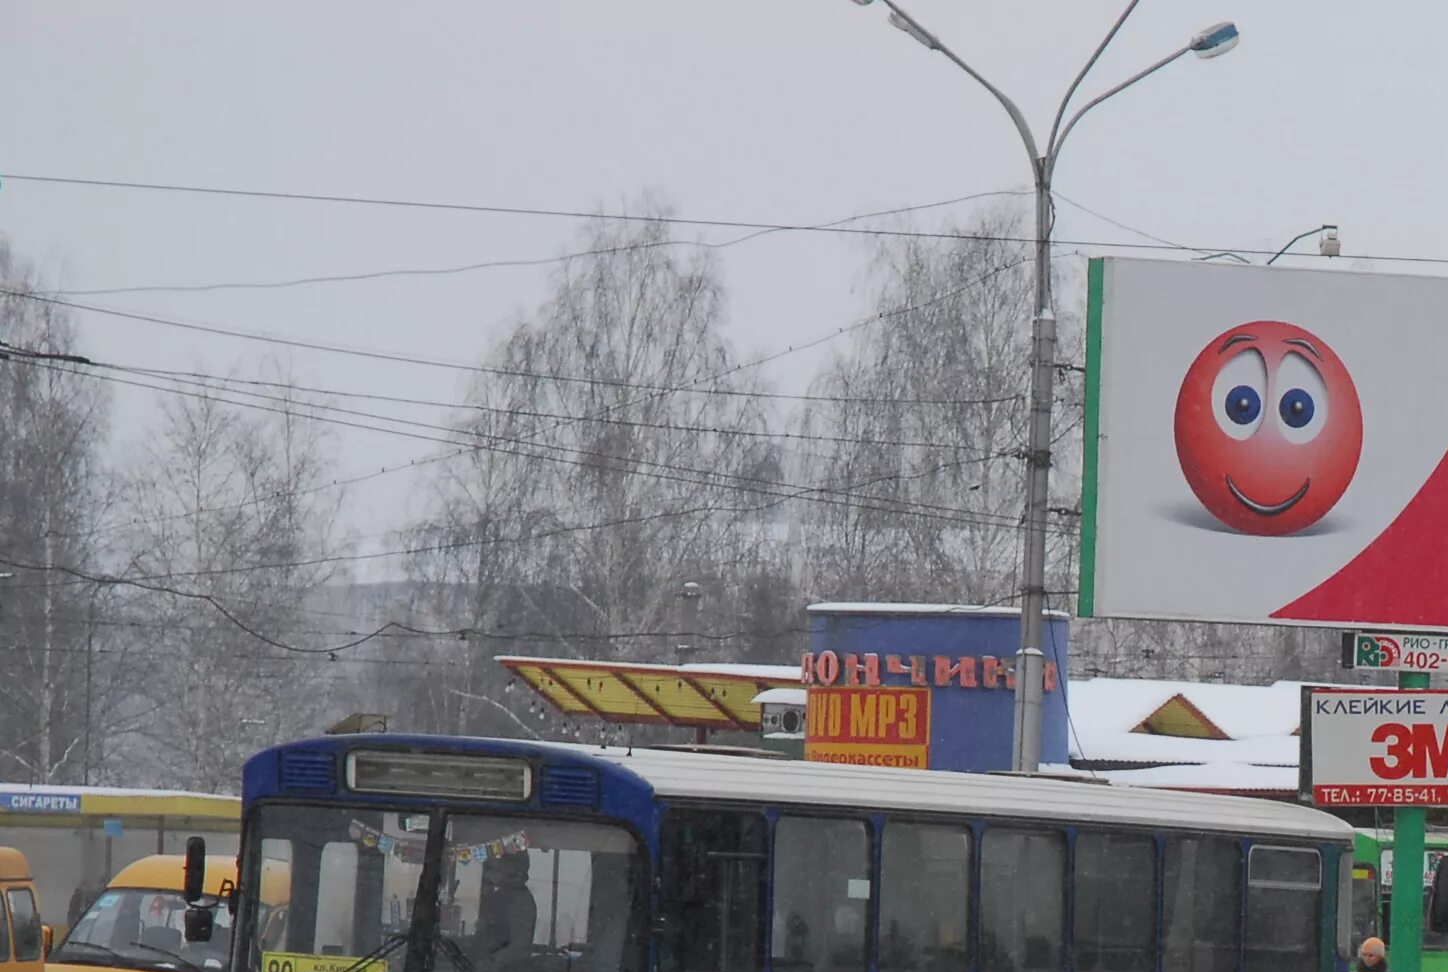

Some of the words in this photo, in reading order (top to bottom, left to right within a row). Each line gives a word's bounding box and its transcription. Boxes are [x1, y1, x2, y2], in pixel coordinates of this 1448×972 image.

[1316, 697, 1426, 715] КЛЕЙКИЕ
[11, 796, 77, 809] СИГАРЕТЫ
[1321, 788, 1360, 803] ТЕЛ.:
